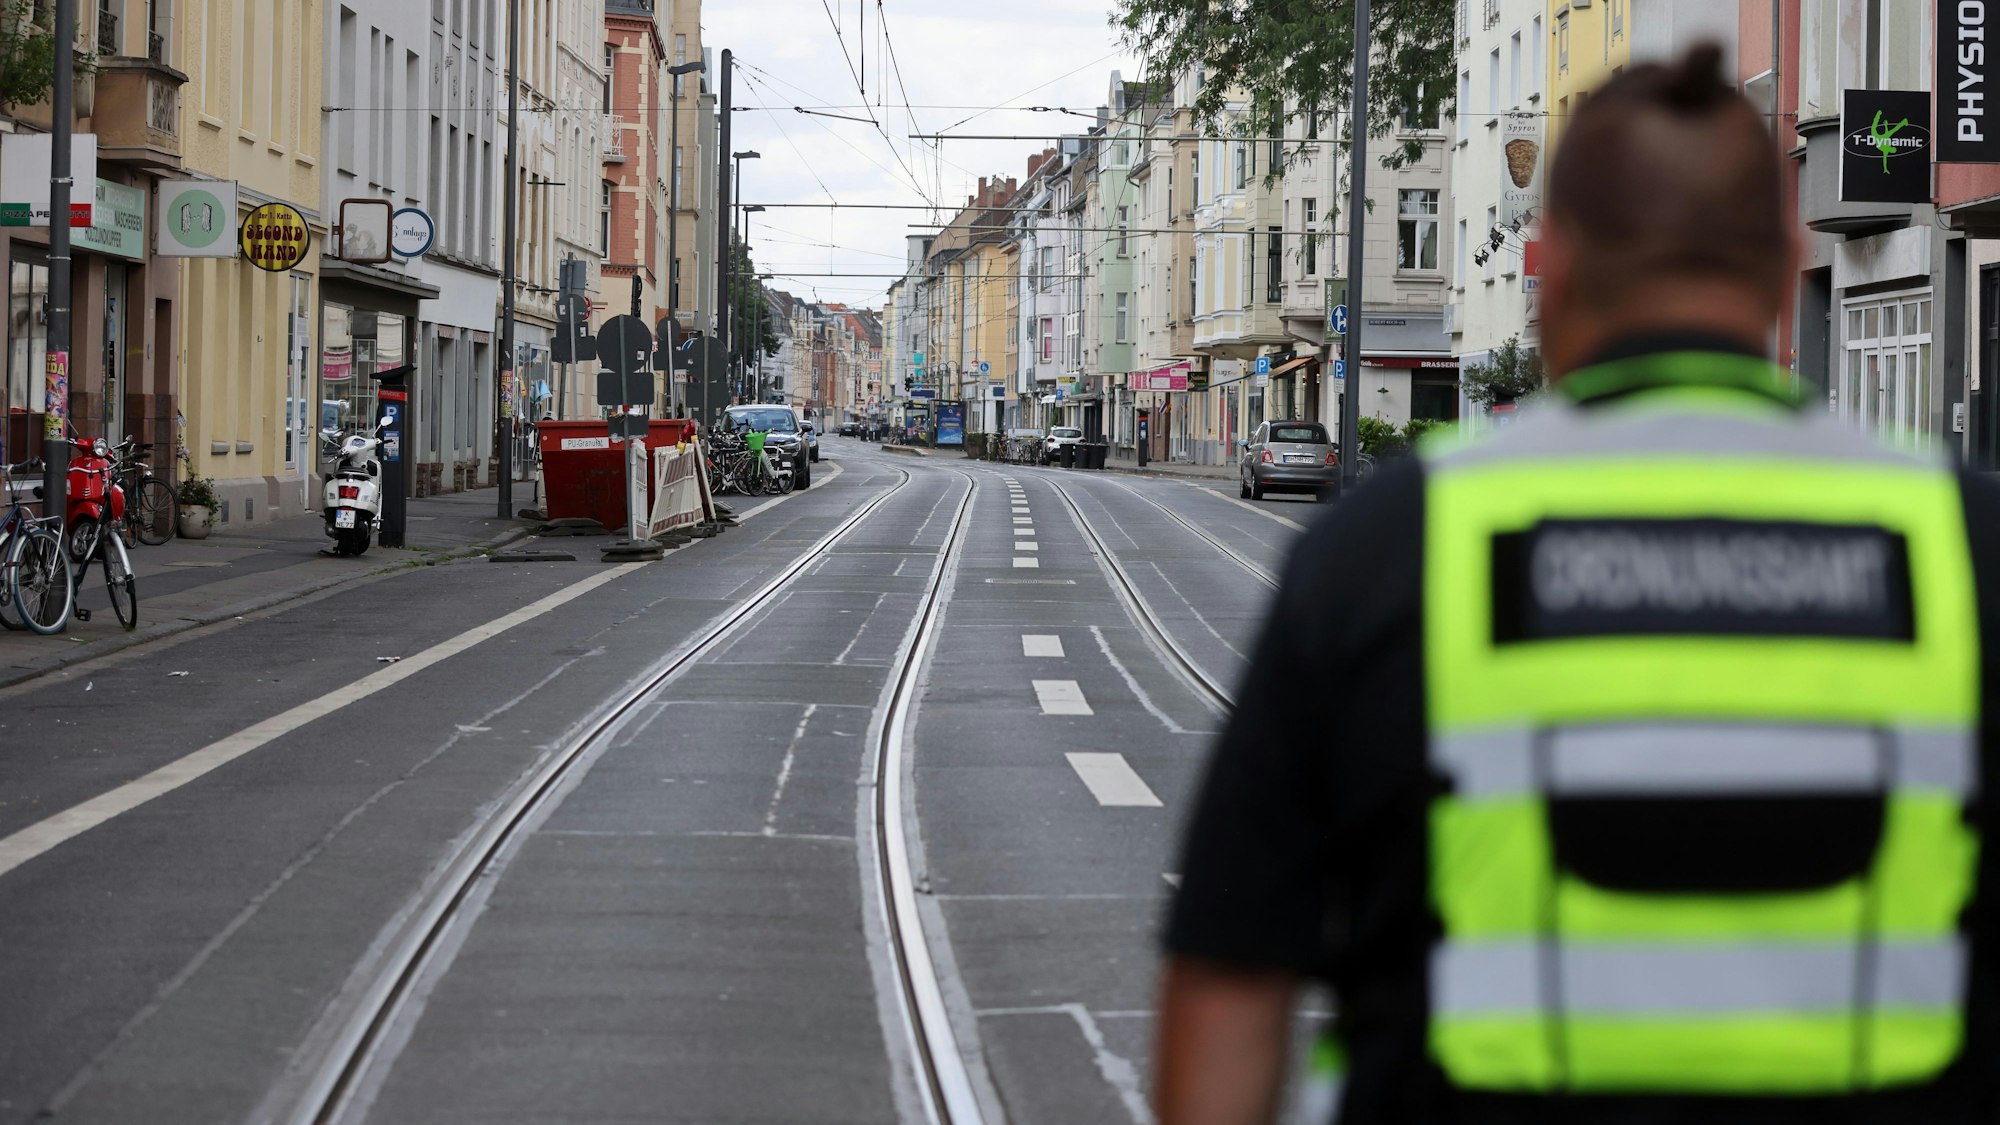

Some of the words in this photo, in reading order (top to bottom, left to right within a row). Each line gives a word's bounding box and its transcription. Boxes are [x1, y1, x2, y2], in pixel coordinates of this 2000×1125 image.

[1957, 0, 1985, 142] PHYSIO
[1507, 123, 1536, 132] Spyros
[1852, 134, 1923, 148] T-Dynamic
[1504, 190, 1540, 203] Gyros
[3, 210, 34, 218] PIZZA
[36, 210, 50, 218] PE
[246, 224, 303, 242] SECOND
[251, 244, 297, 261] HAND
[1258, 359, 1267, 373] P
